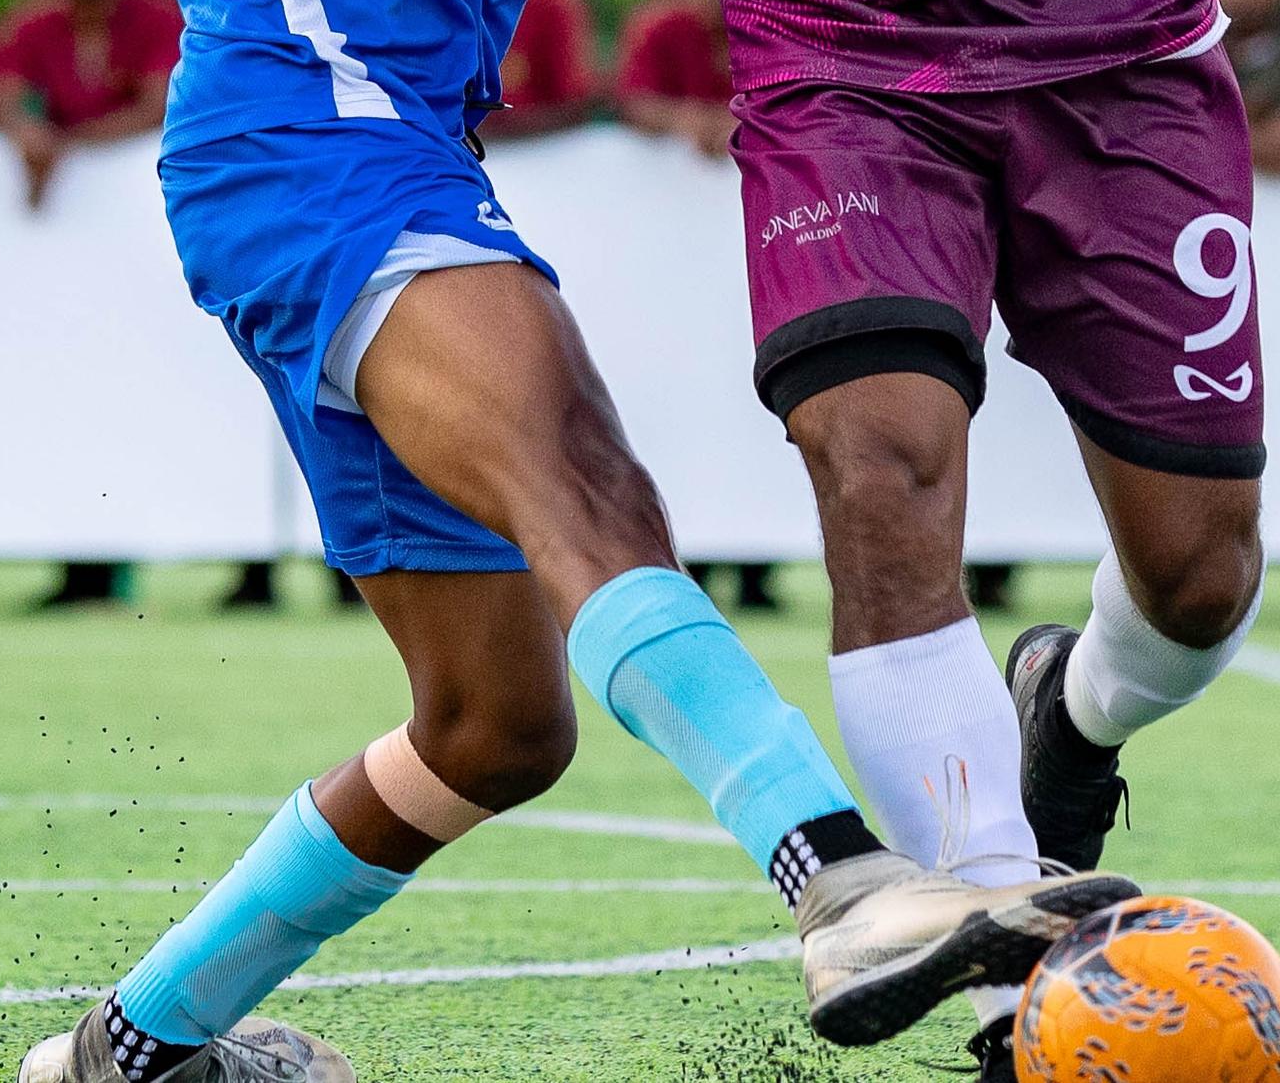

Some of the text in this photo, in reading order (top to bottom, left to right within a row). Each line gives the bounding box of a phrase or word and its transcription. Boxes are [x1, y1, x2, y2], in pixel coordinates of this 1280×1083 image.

[761, 191, 880, 249] SONEVA JANI
[795, 221, 842, 246] MALDIVES
[1173, 212, 1251, 353] 9
